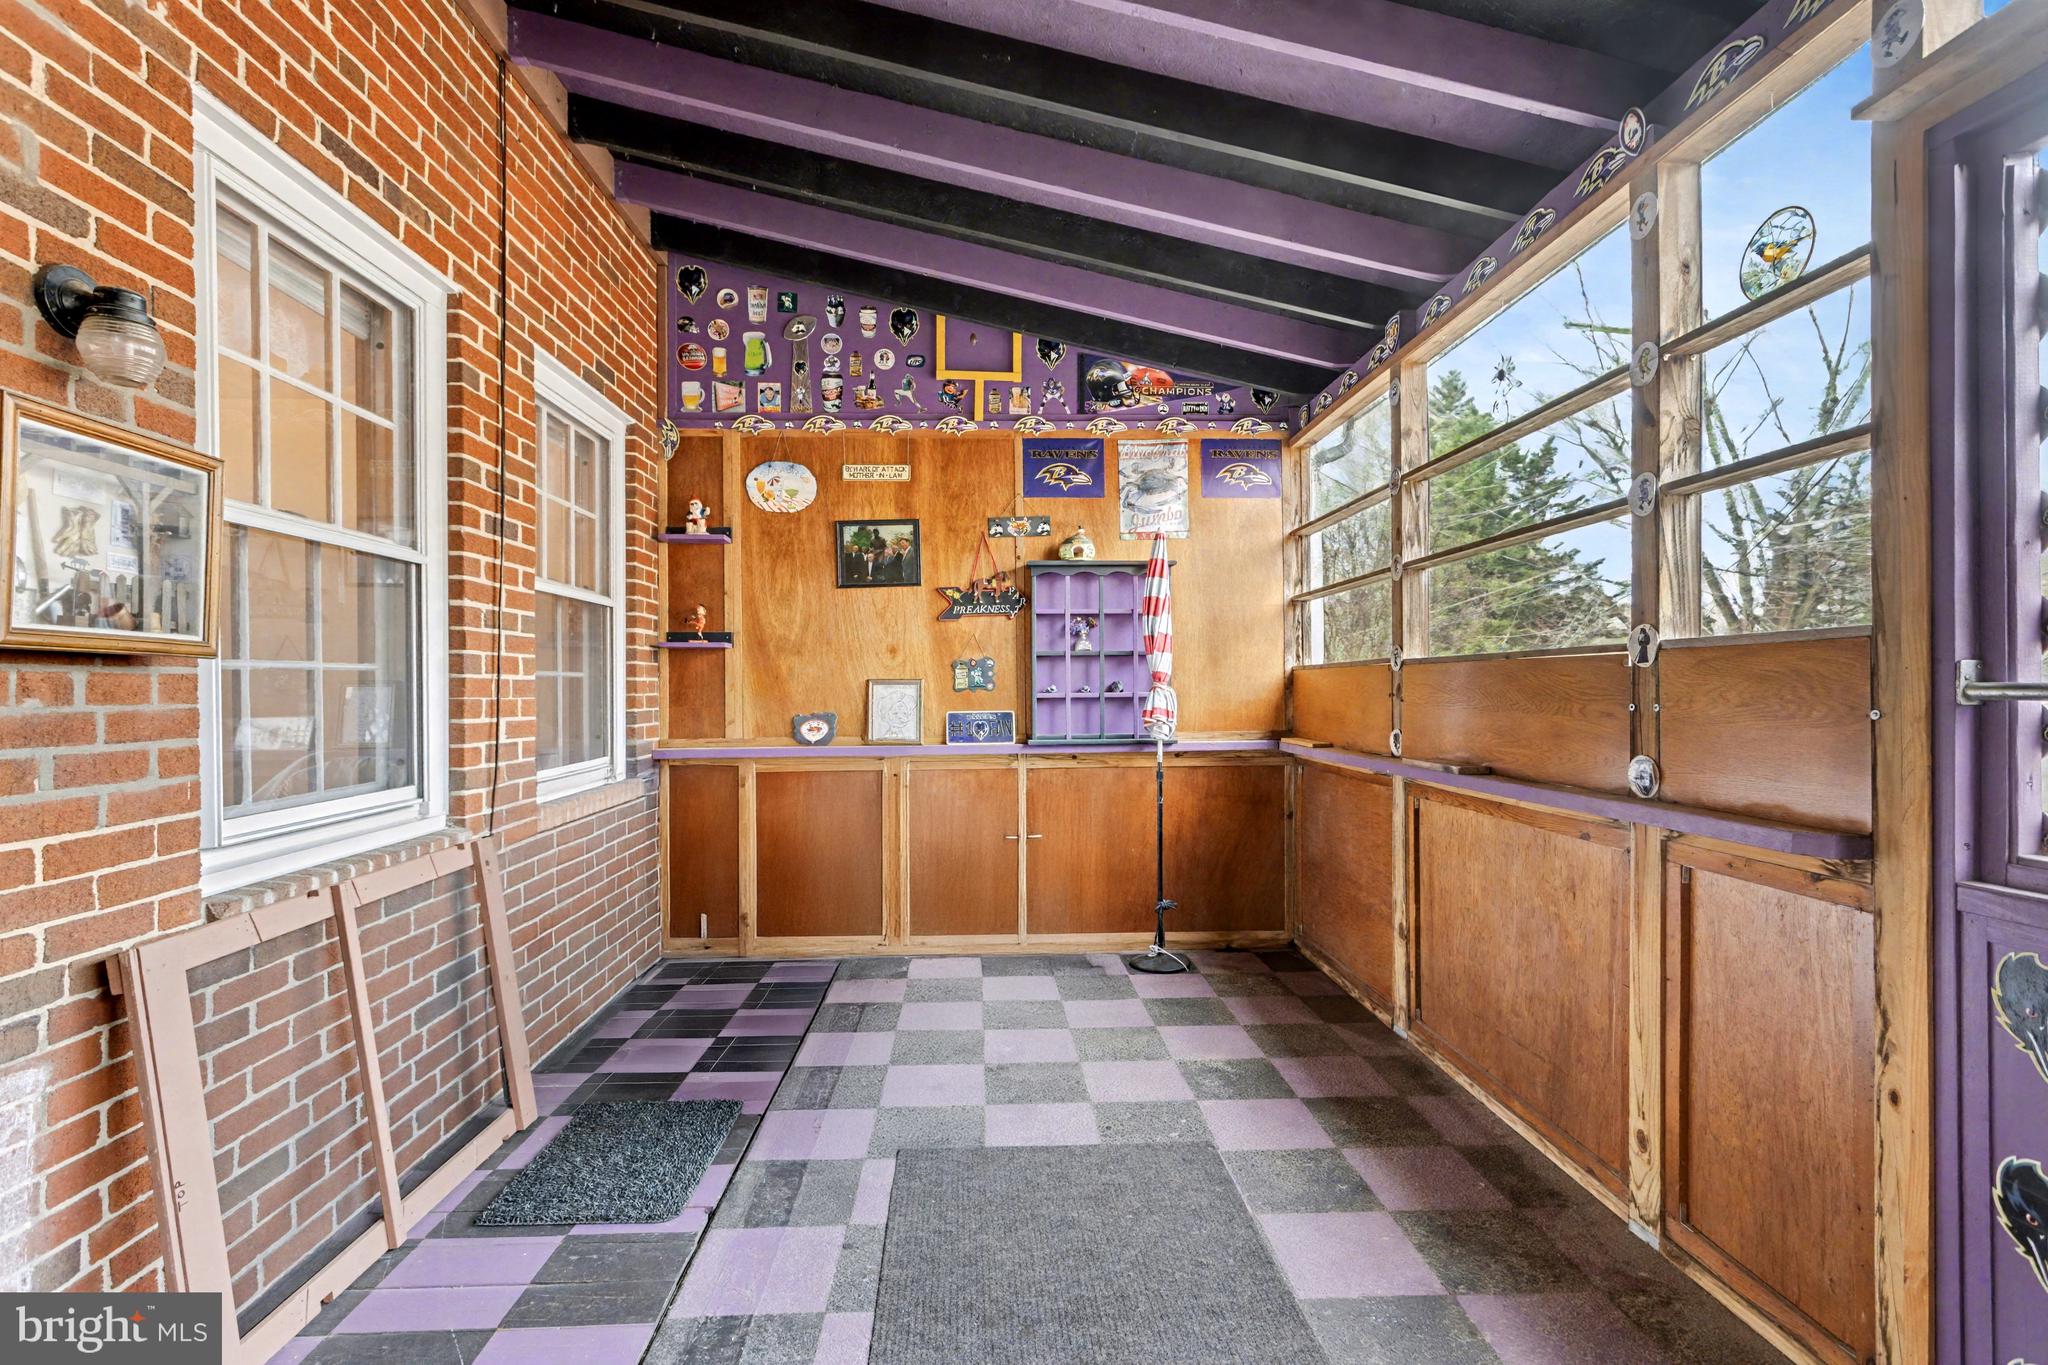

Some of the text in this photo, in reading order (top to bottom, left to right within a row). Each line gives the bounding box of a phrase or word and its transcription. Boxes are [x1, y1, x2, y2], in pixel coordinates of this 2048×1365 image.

[1141, 386, 1212, 396] CHAMPIONS
[1029, 449, 1098, 459] RAVENS
[1209, 449, 1279, 459] RAVENS
[953, 604, 1010, 615] PREAKNESS
